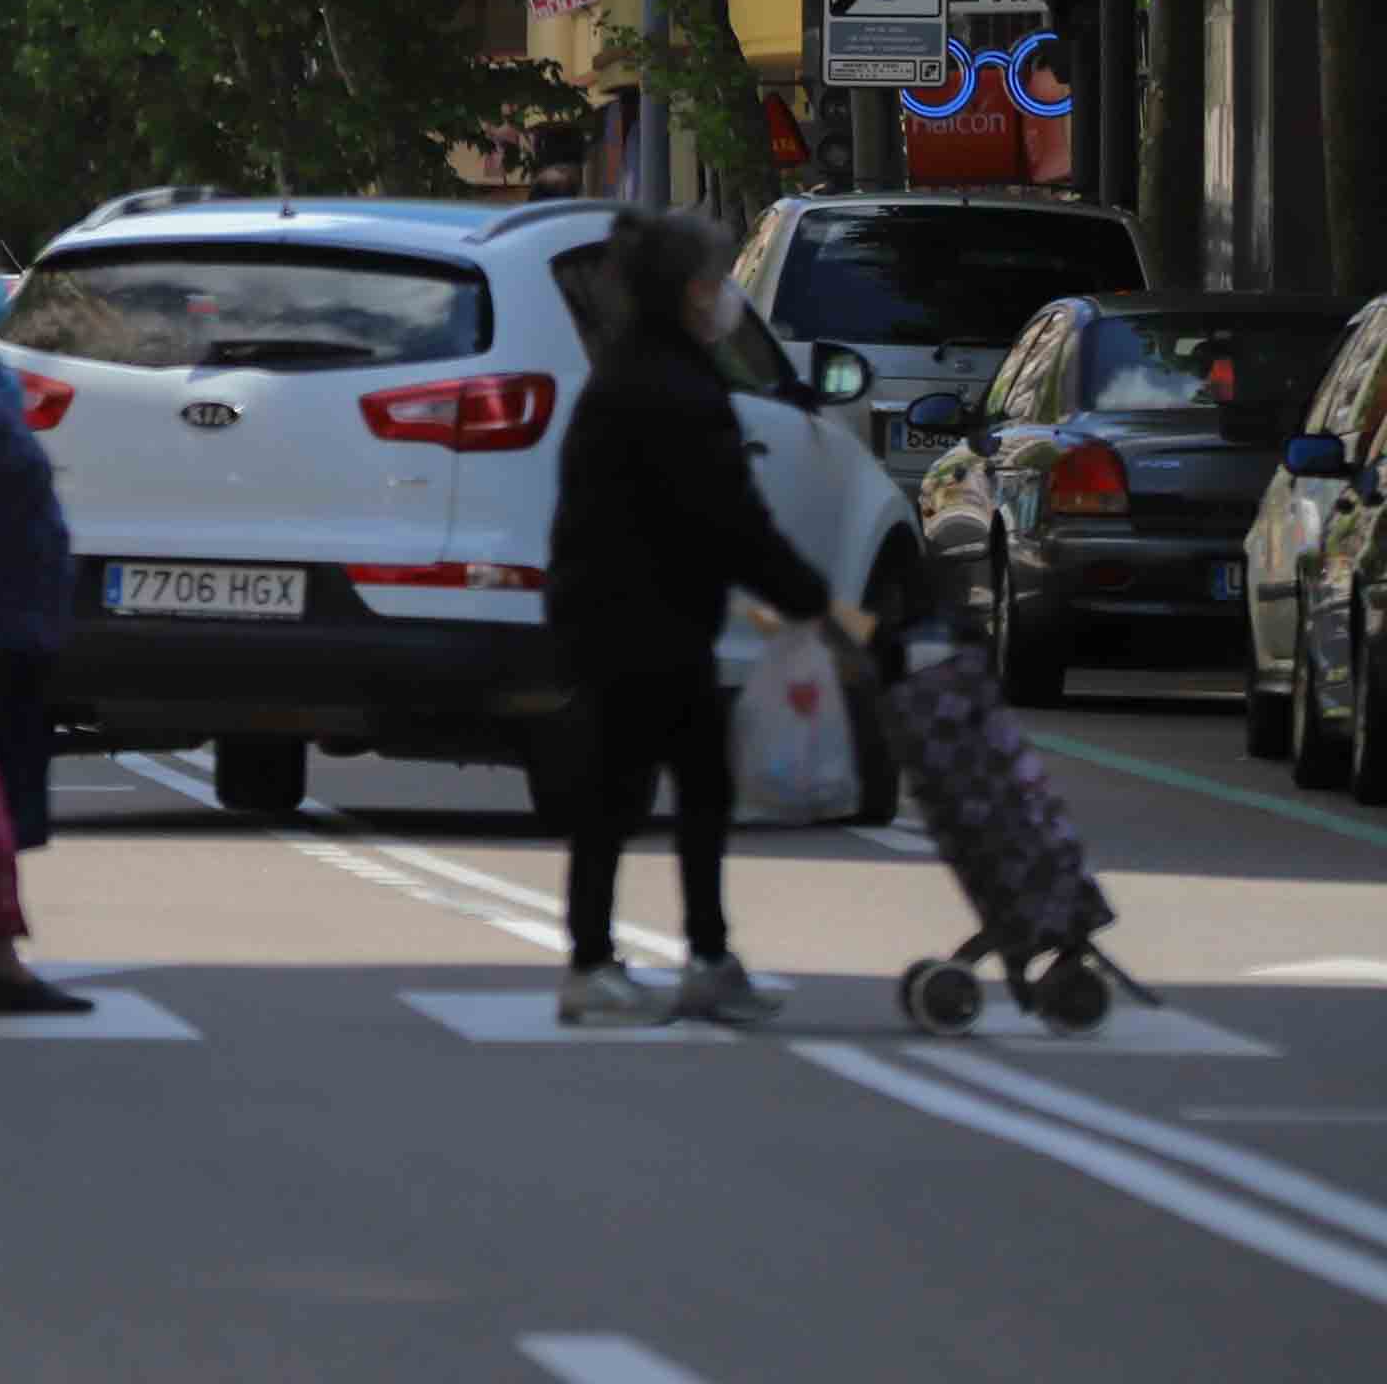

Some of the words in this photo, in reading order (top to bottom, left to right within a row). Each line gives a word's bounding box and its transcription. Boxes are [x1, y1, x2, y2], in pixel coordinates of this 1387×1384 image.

[186, 406, 235, 425] KIA
[130, 569, 217, 603] 7706
[228, 573, 295, 606] HGX
